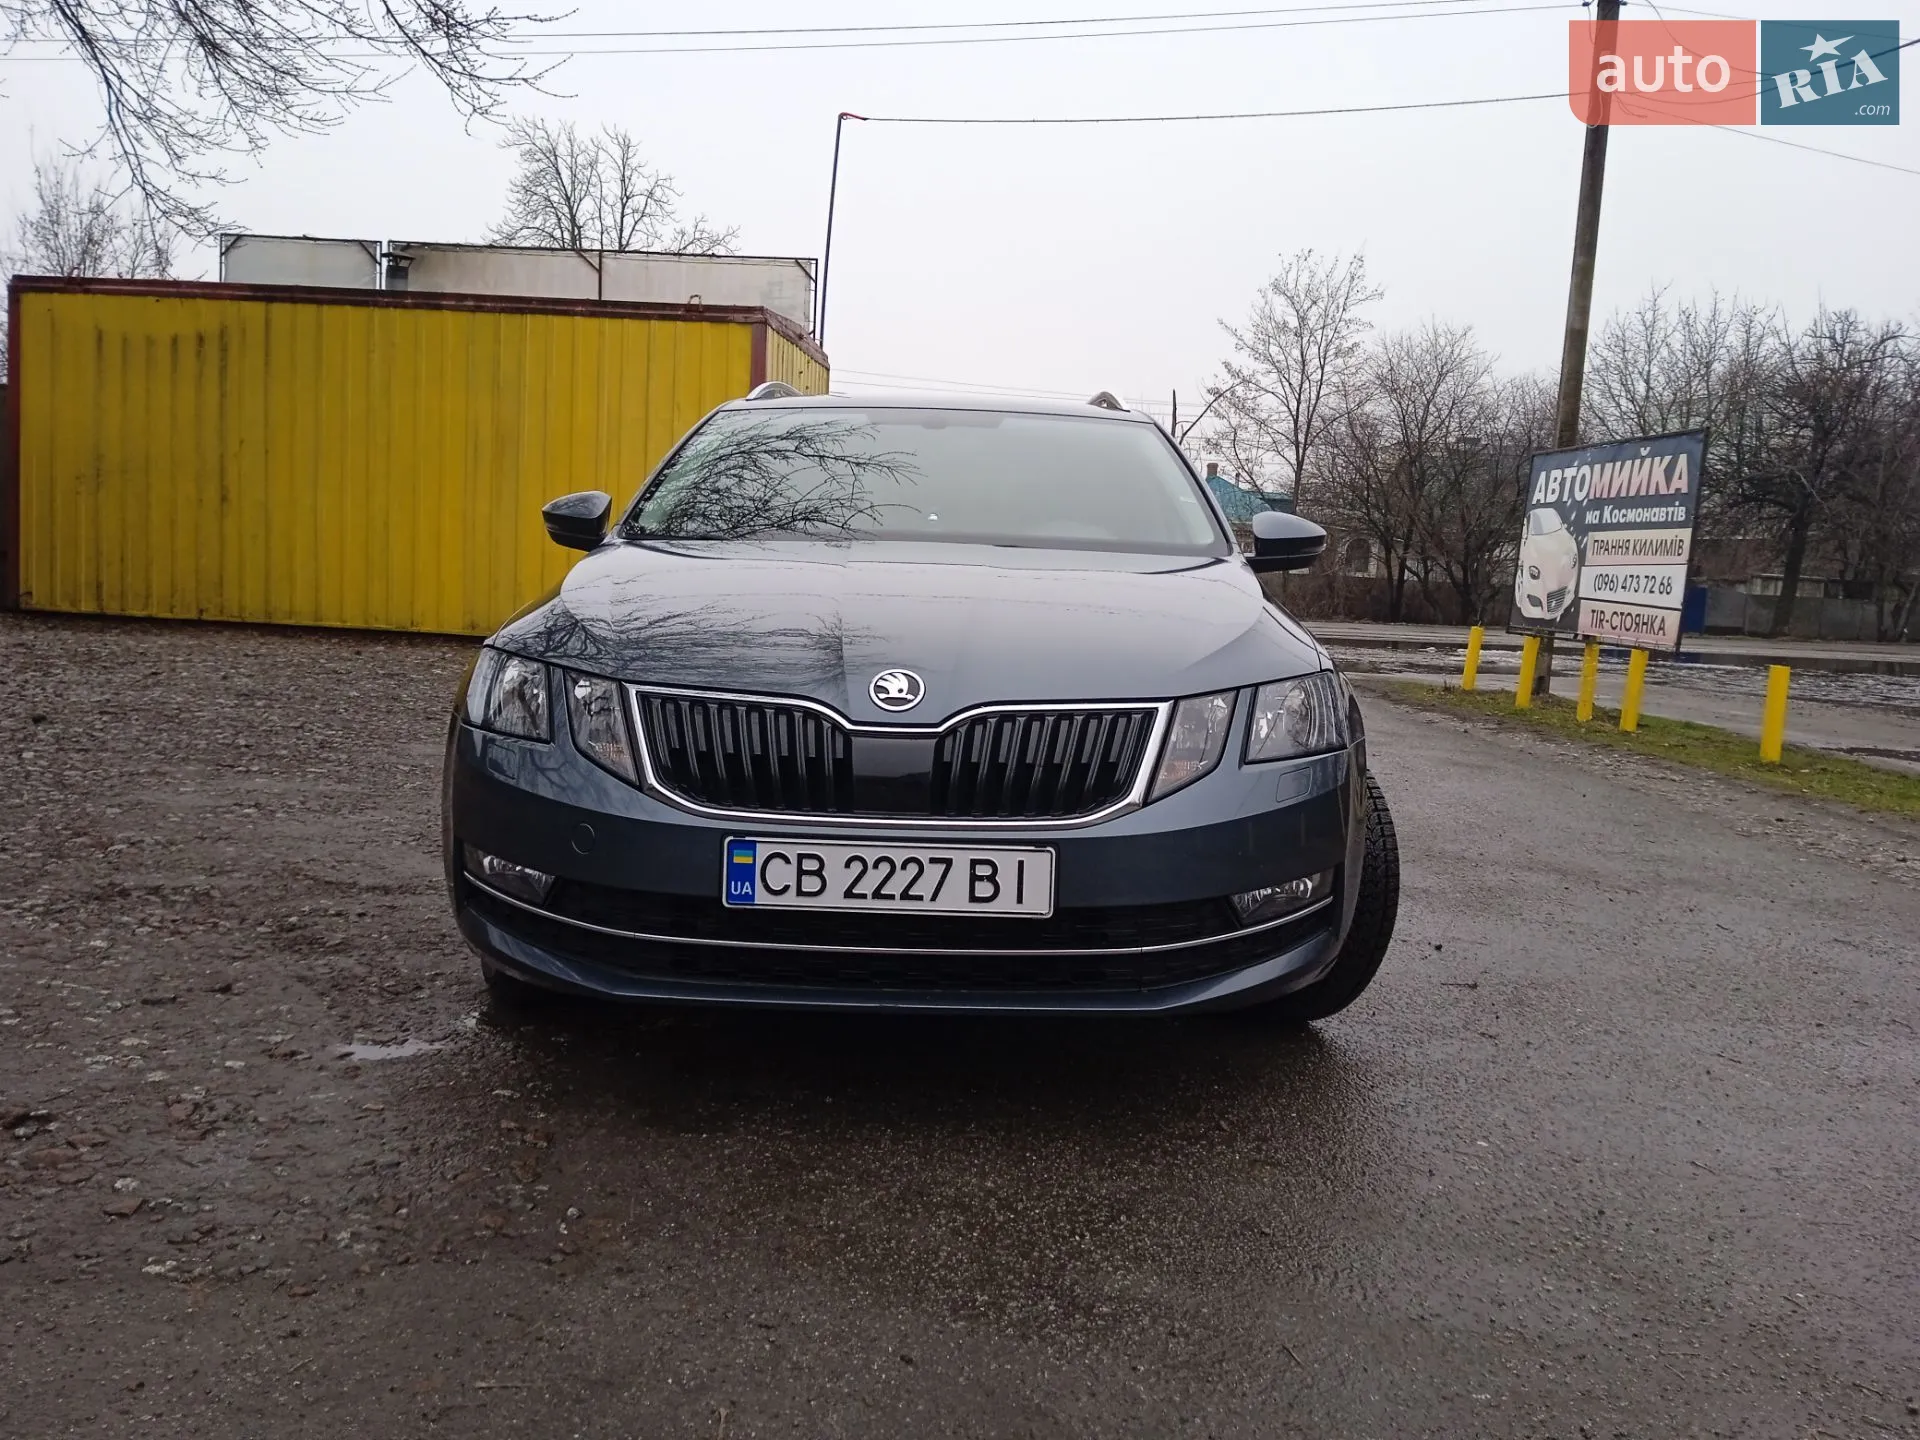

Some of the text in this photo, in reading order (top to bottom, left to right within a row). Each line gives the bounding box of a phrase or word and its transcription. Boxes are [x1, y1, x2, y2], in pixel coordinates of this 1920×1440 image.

[1532, 447, 1689, 505] АВТОМИЙКА
[1585, 501, 1686, 524] на Космонавтів
[1592, 539, 1630, 557] ПРАННЯ
[1593, 574, 1619, 593] (096)
[1621, 575, 1640, 594] 473
[1643, 577, 1657, 594] 72
[760, 852, 828, 897] CB
[843, 855, 954, 902] 2227
[731, 881, 753, 896] UA
